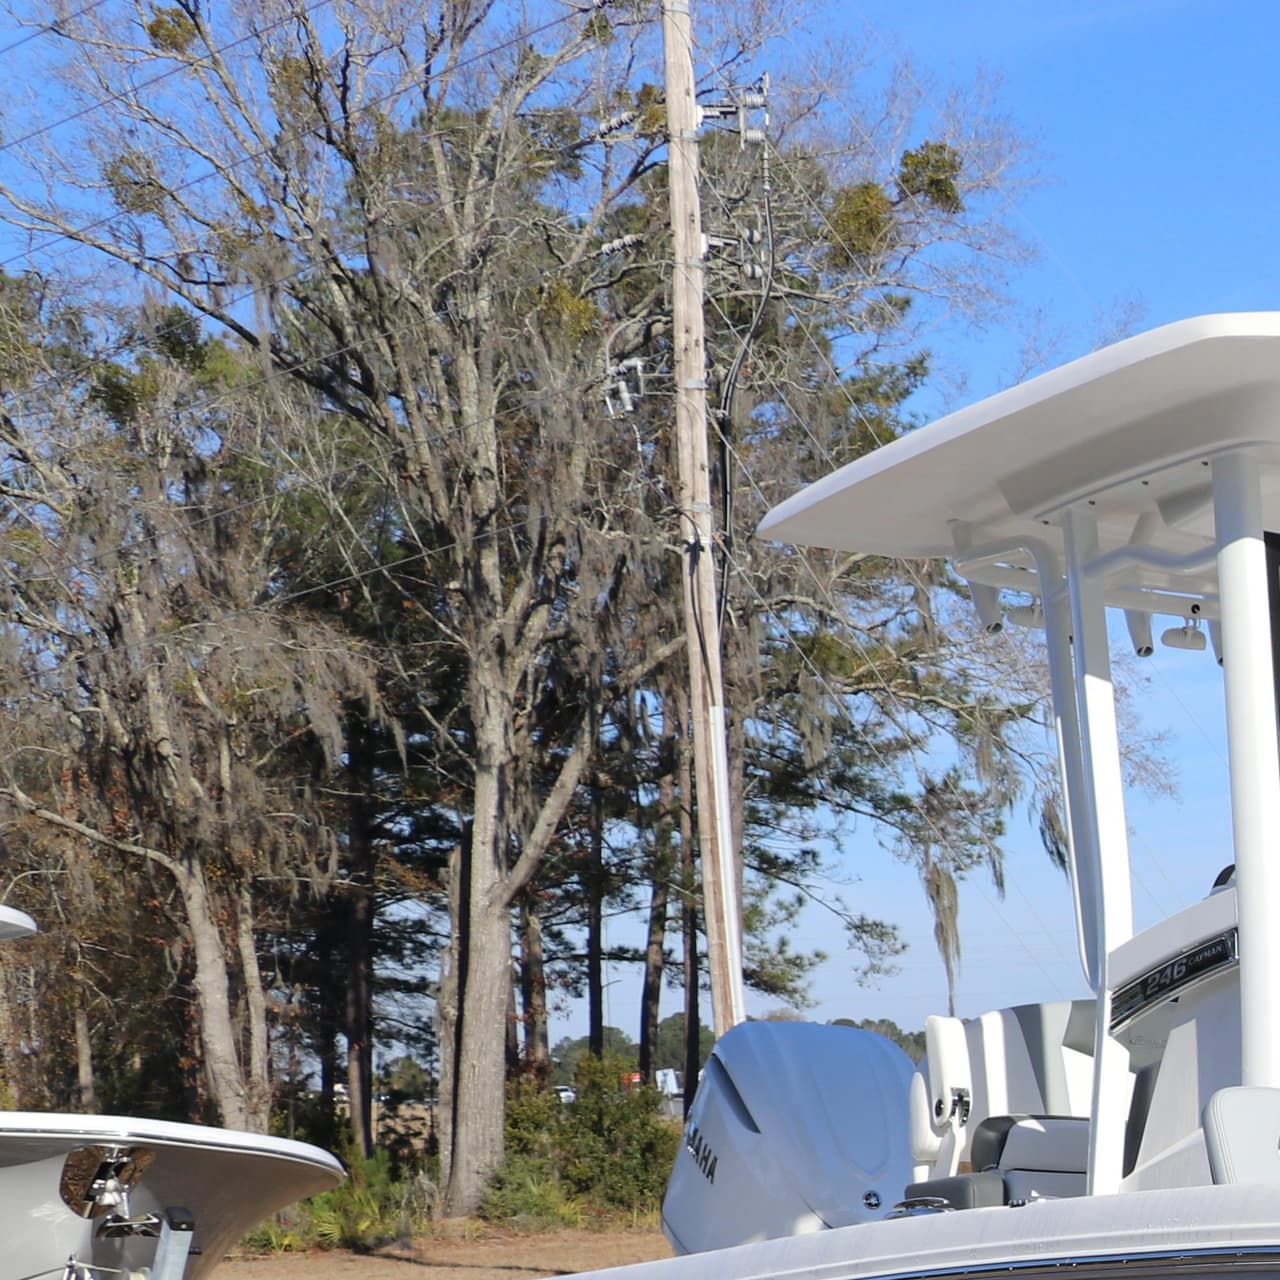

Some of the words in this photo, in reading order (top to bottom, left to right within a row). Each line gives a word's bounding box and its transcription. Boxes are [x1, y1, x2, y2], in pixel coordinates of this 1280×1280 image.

[1145, 959, 1189, 995] 246
[1188, 943, 1224, 966] CAYMAN
[686, 1127, 718, 1186] MAHA
